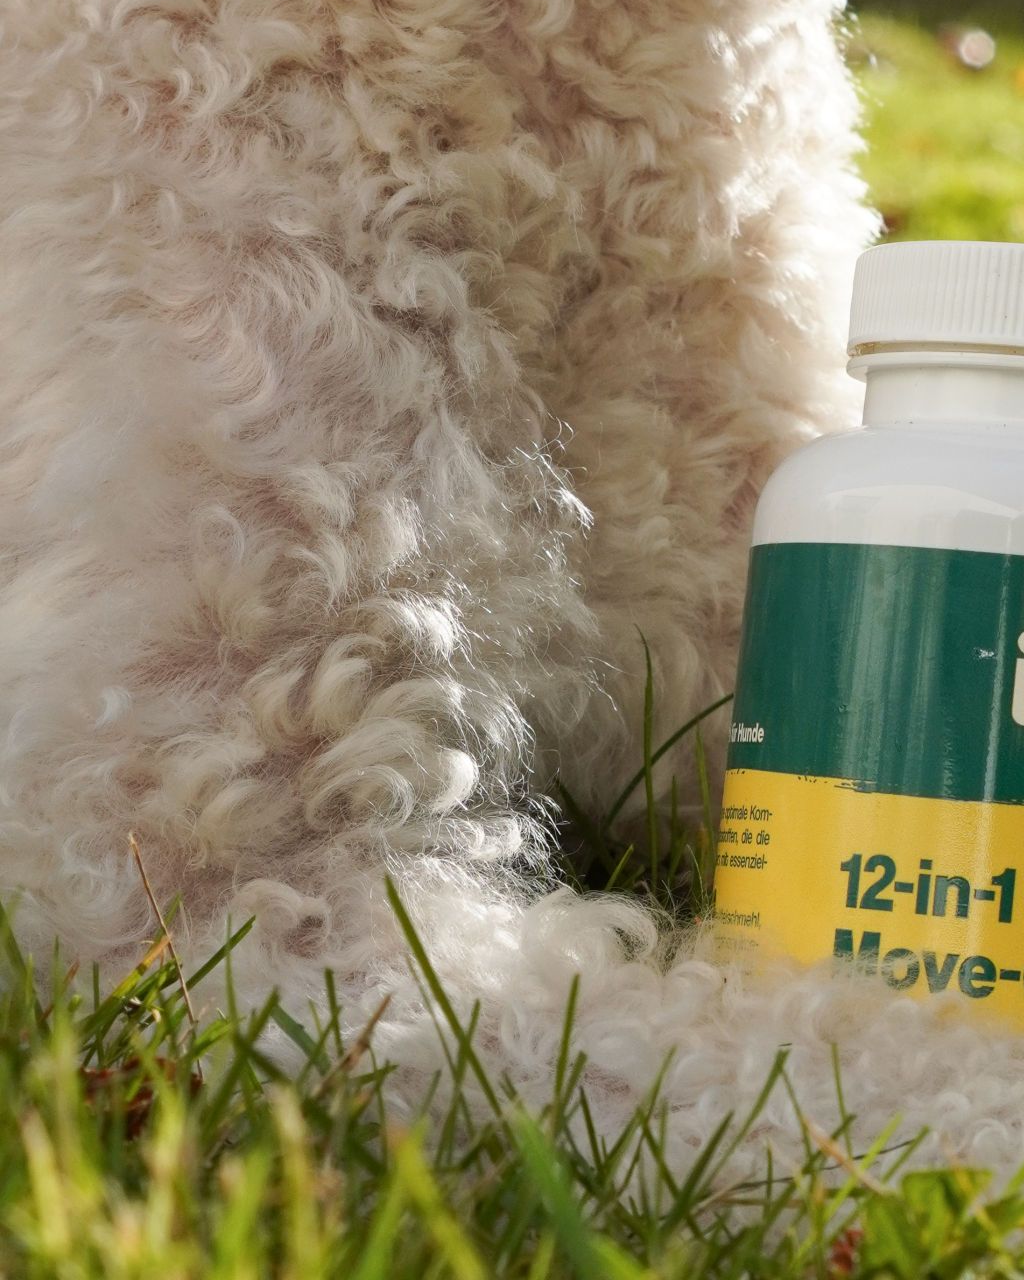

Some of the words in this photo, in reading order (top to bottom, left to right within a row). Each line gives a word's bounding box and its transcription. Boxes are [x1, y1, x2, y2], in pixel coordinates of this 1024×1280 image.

[737, 722, 765, 743] Hunde
[749, 805, 773, 821] Kom-
[741, 829, 753, 844] die
[756, 830, 770, 845] die
[729, 853, 768, 870] essenziel-
[840, 853, 1017, 923] 12-in-1
